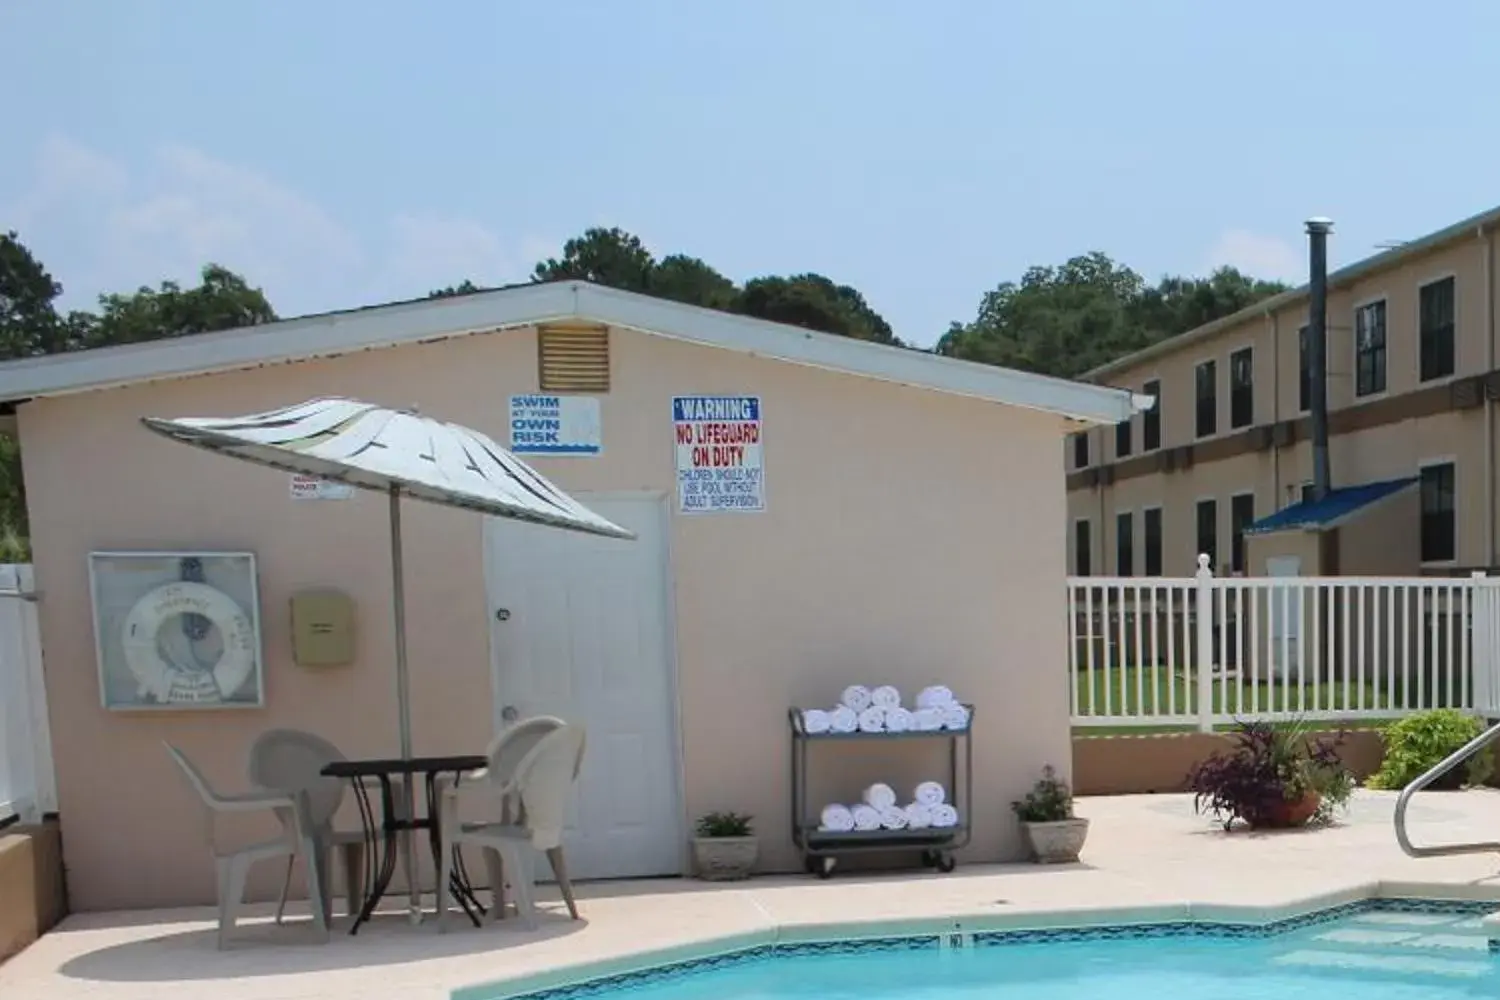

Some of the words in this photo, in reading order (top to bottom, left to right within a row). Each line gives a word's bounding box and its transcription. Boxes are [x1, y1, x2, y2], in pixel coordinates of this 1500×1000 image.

[512, 397, 559, 408] SWIM
[681, 399, 751, 419] WARNING
[512, 419, 560, 430] OWN
[513, 431, 559, 443] RISK
[676, 424, 693, 444] NO
[697, 423, 759, 444] LIFEGUARD
[693, 447, 709, 466] ON
[713, 447, 744, 466] DUTY
